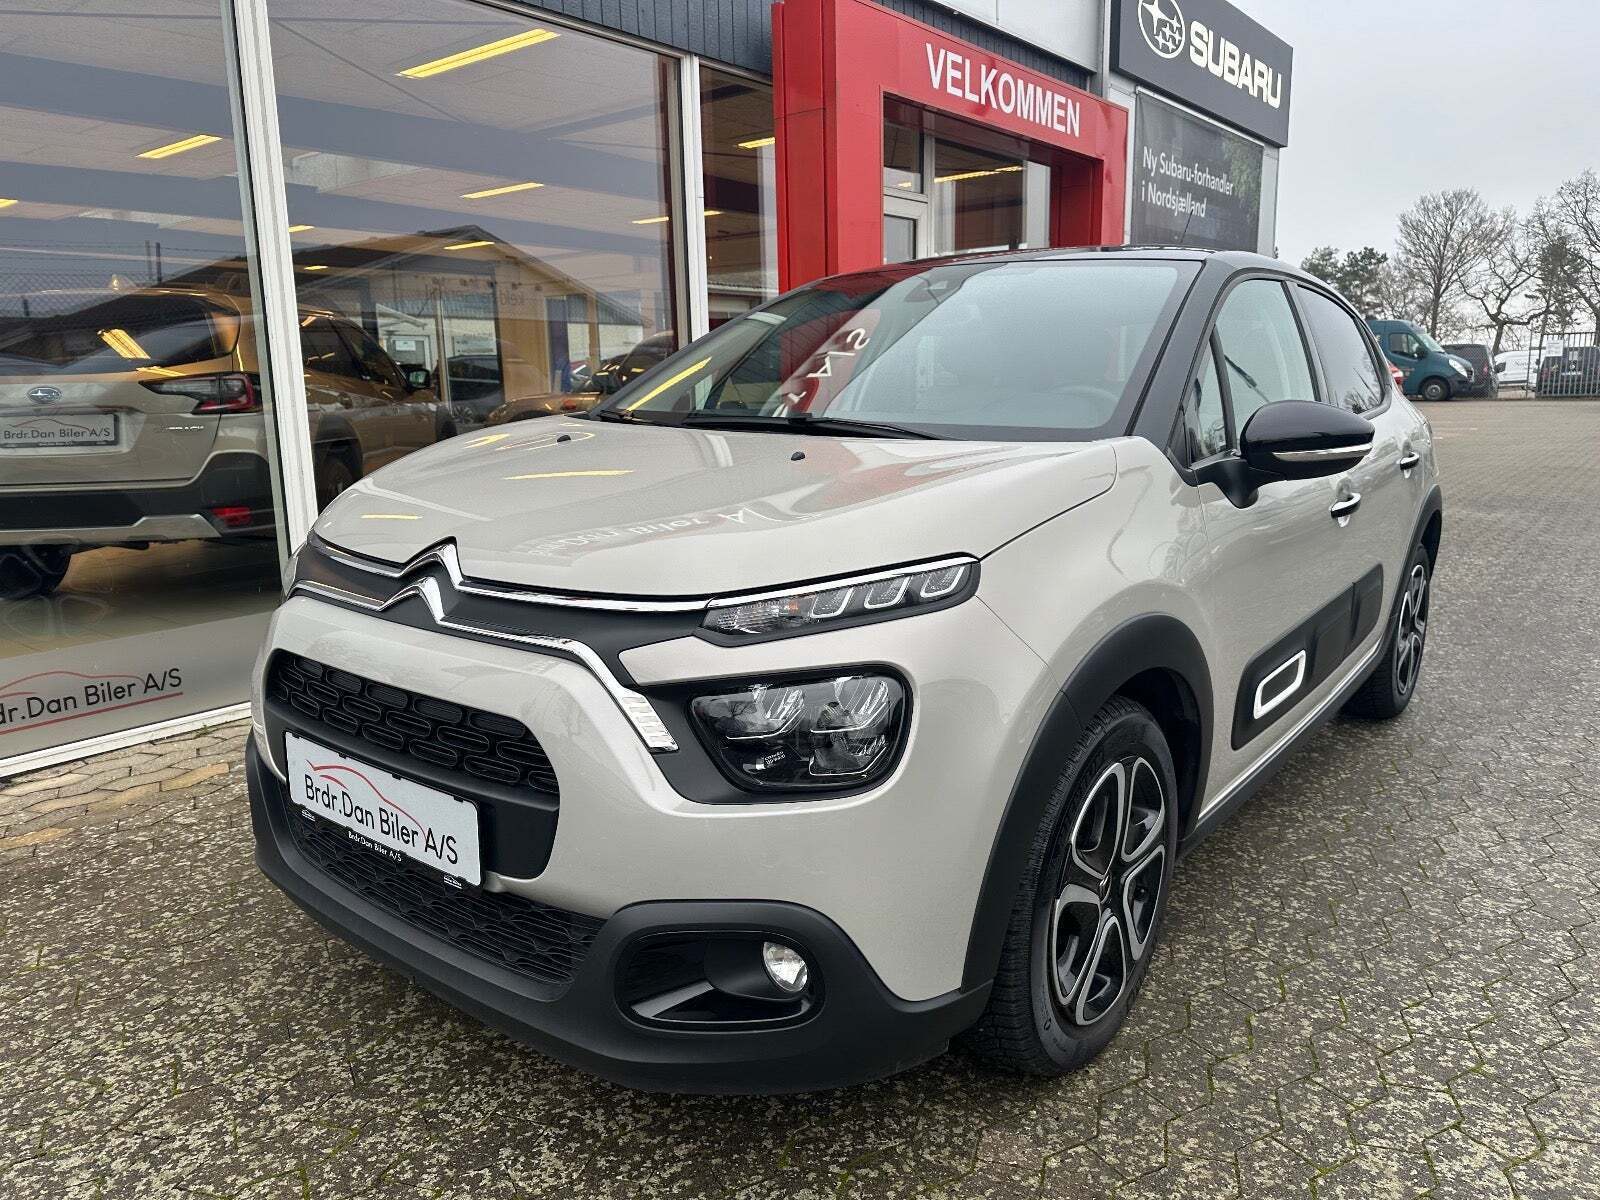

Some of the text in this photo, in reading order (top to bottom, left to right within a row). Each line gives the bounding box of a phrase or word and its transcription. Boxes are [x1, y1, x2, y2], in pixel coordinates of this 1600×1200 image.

[1189, 20, 1282, 109] SUBARU
[925, 43, 1080, 138] VELKOMMEN
[1143, 146, 1234, 195] Ny Subaru-forhandler
[1141, 180, 1207, 218] i Nordsjælland
[3, 428, 111, 440] Brdr.Dan Biler A/S
[84, 680, 136, 706] Biler
[143, 668, 182, 694] A/S
[304, 774, 459, 865] Brdr.Dan Biler A/S
